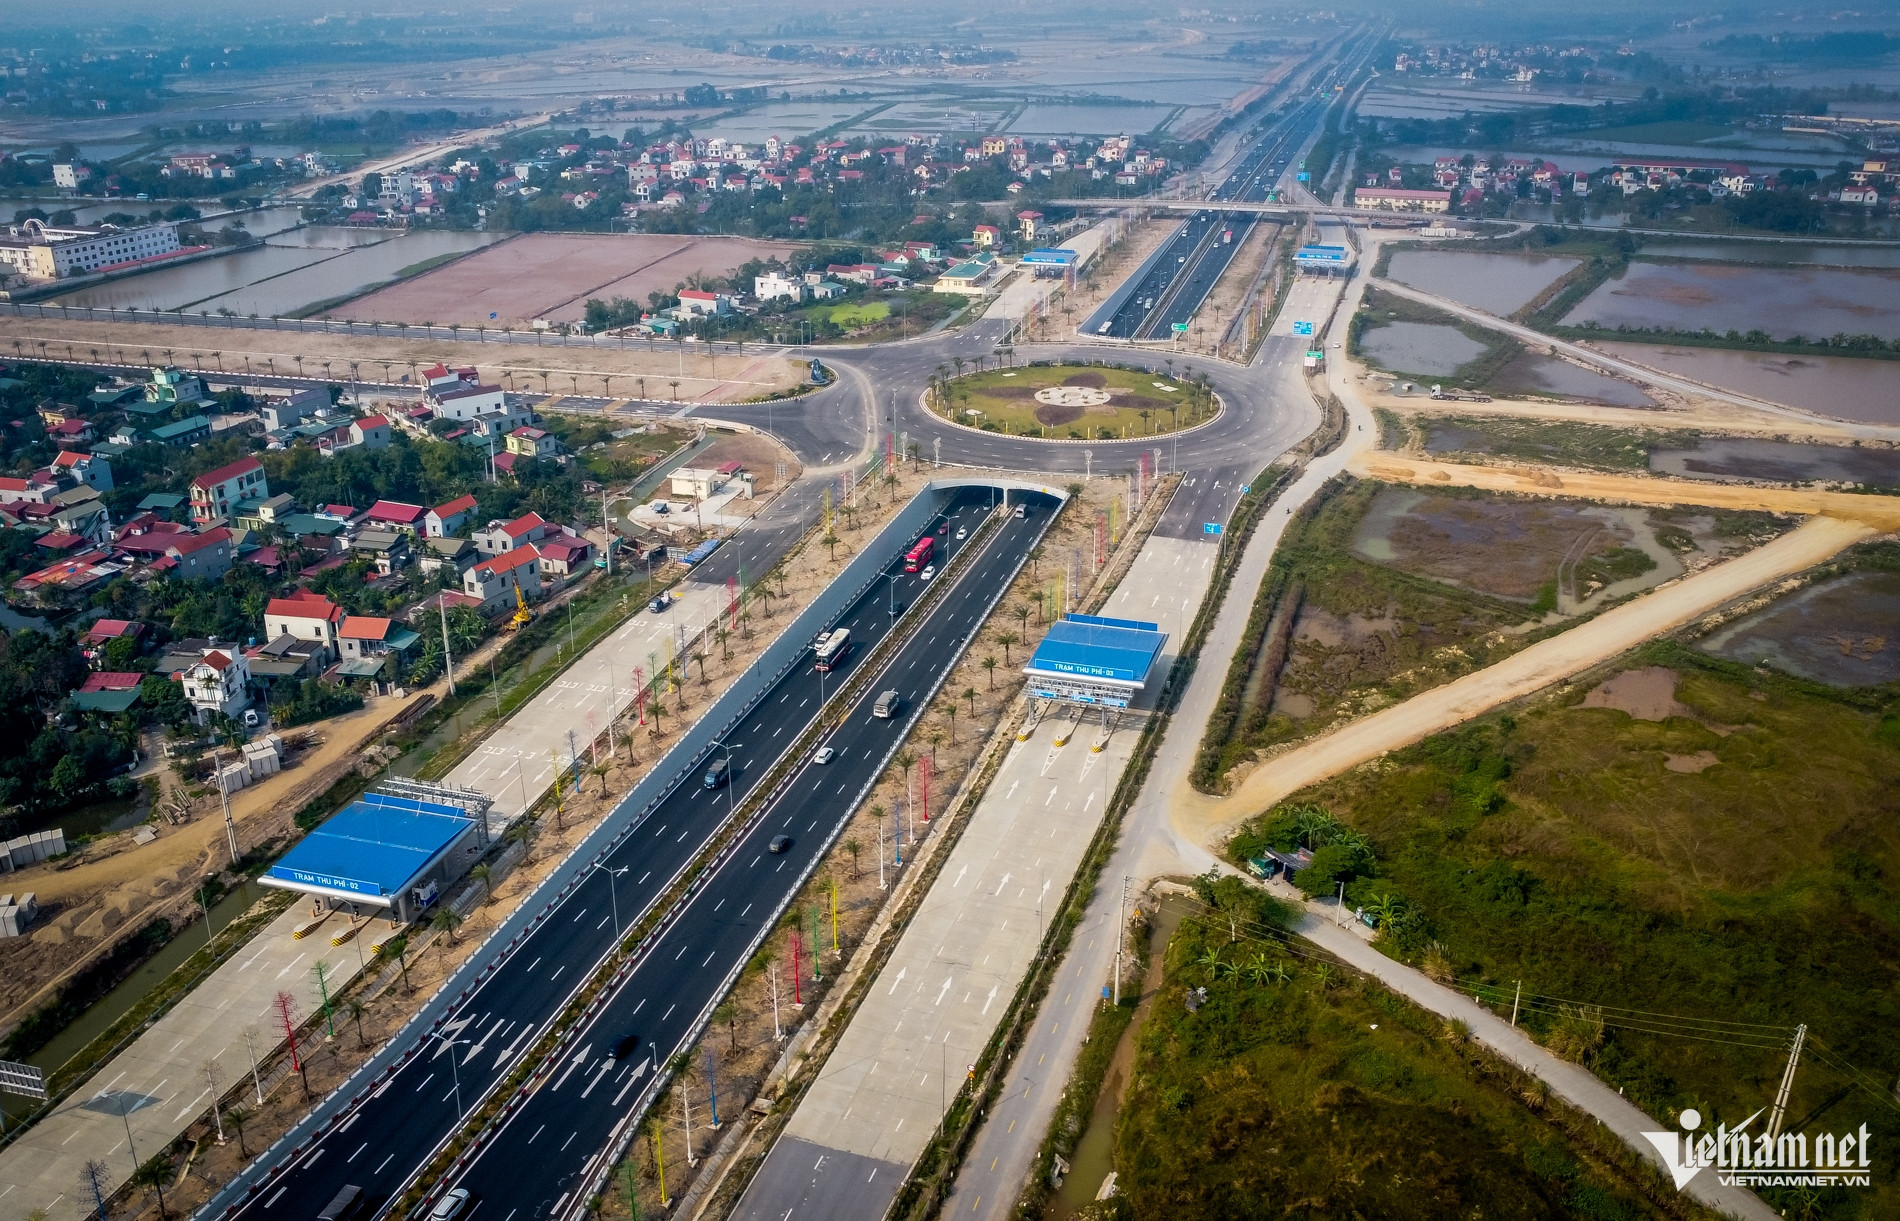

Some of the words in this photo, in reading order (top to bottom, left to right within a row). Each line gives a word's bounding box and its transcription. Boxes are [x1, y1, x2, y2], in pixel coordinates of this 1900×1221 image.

[557, 680, 579, 689] ETC
[585, 684, 607, 692] ETC
[483, 746, 506, 755] ETC
[317, 876, 331, 885] THU
